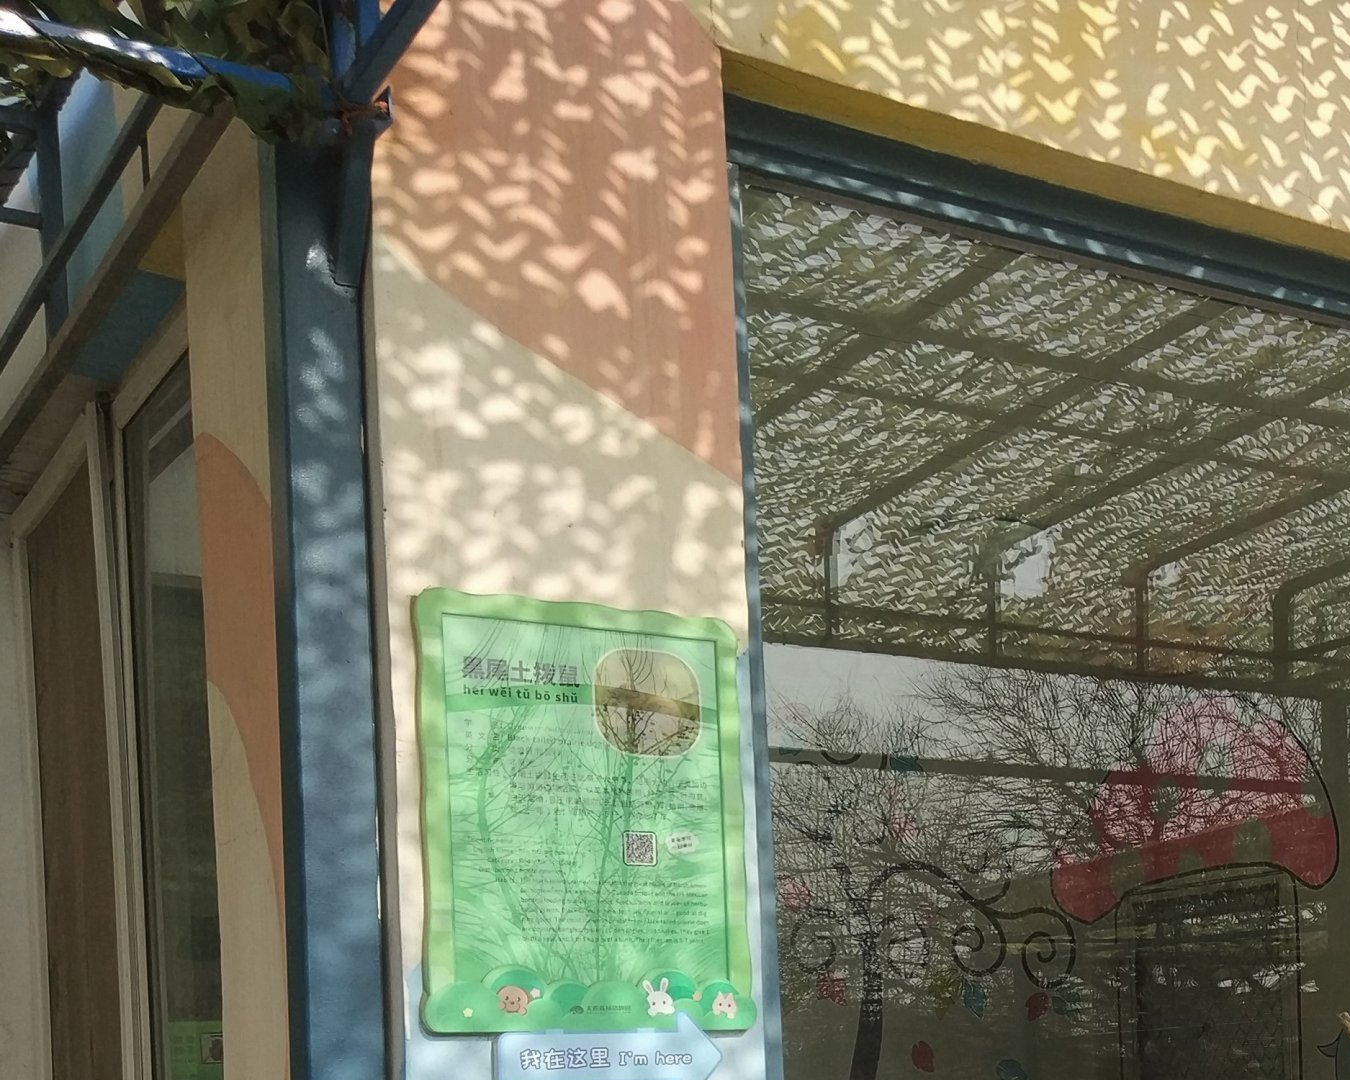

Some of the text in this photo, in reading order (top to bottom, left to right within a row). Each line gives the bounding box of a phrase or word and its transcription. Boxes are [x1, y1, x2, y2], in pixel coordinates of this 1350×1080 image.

[462, 656, 580, 687] 黑尾土拨鼠
[520, 1047, 692, 1070] 我在这里 I'm here
